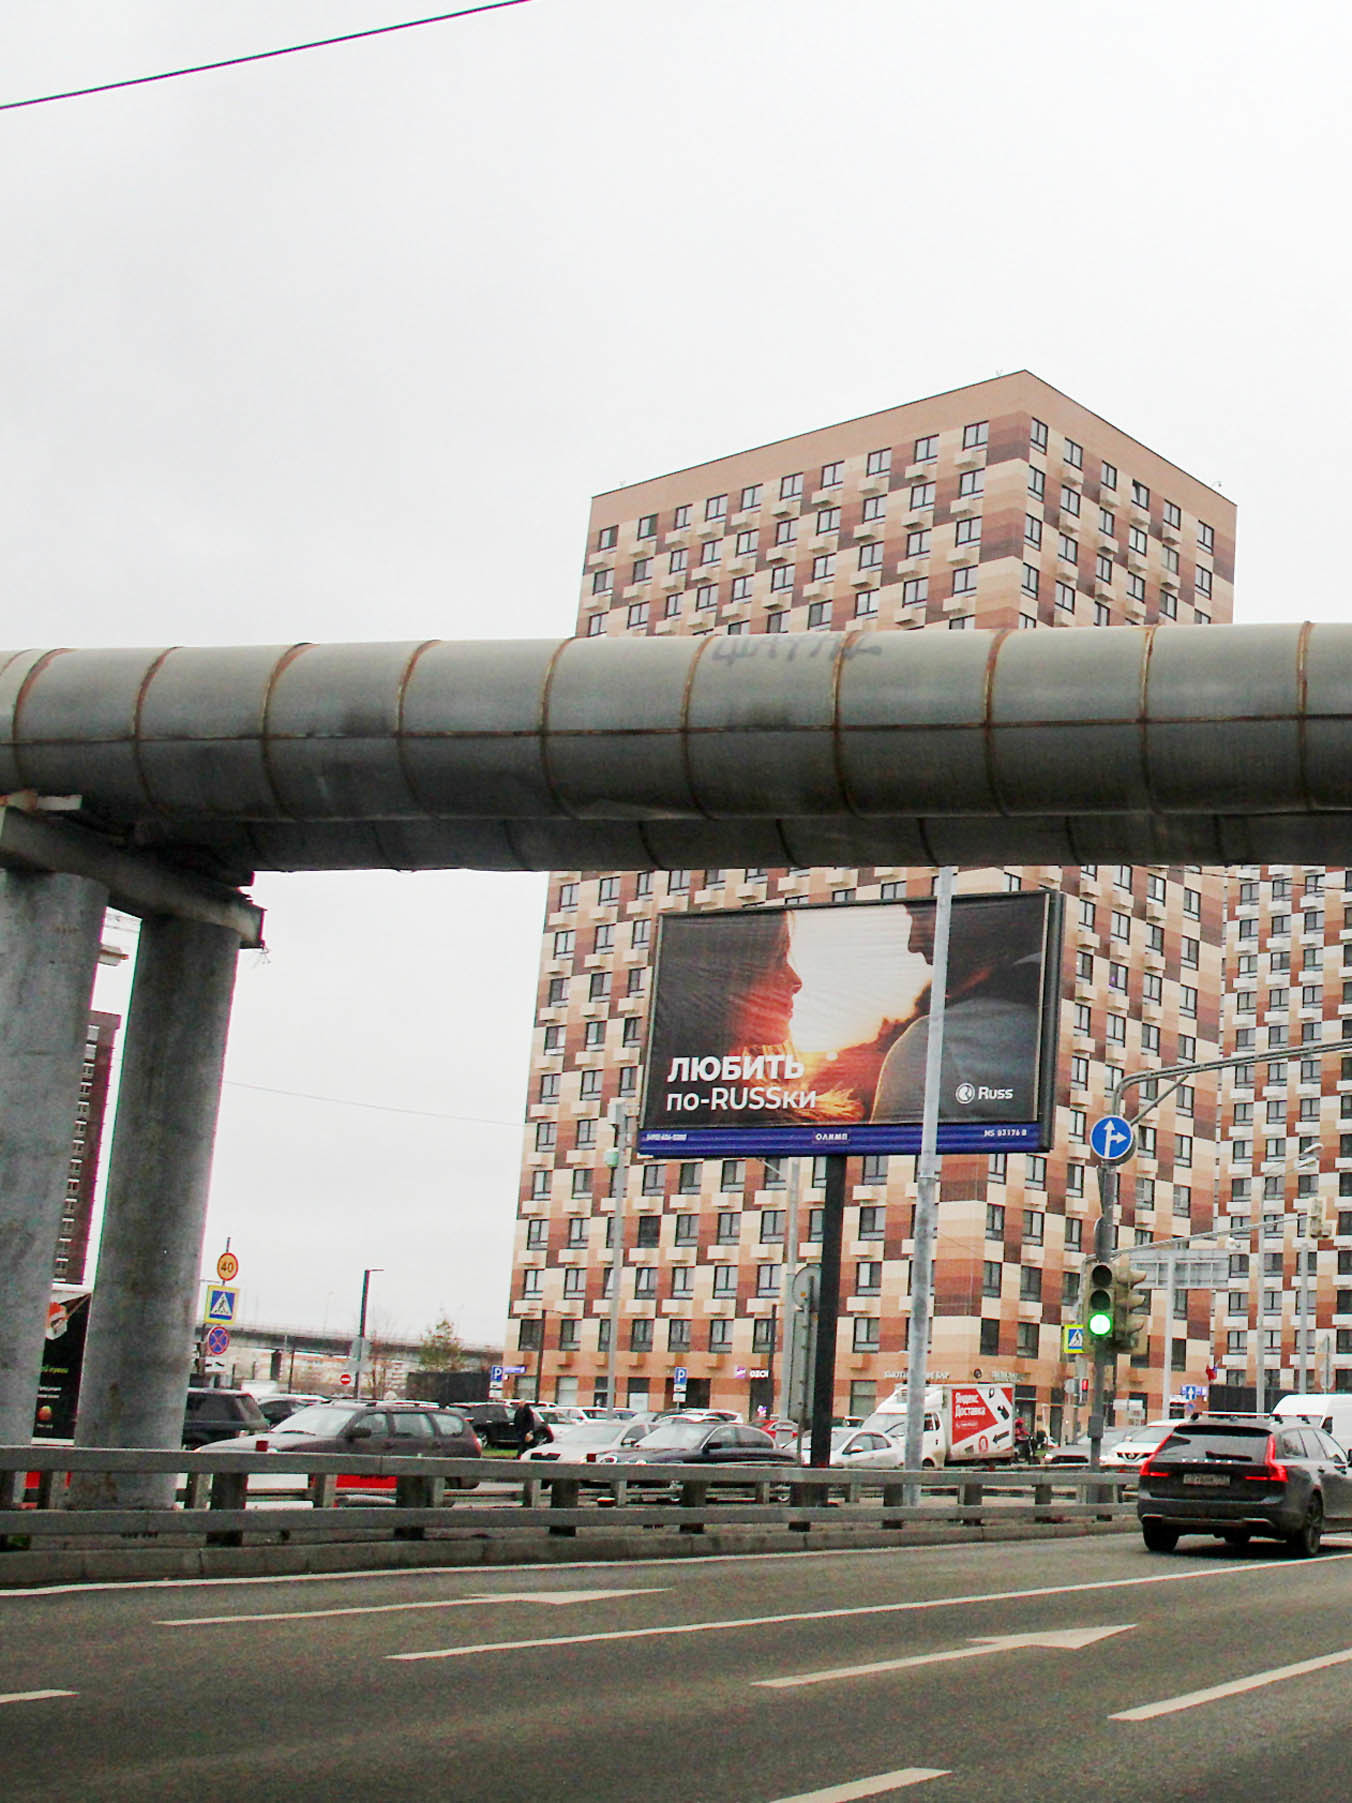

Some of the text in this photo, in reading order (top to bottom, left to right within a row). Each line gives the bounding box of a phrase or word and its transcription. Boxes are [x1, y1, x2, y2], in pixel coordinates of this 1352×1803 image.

[667, 1054, 806, 1083] ЛЮБИТЬ
[666, 1086, 817, 1112] по-RUSSки
[978, 1086, 1014, 1100] Russ
[220, 1262, 234, 1273] 40
